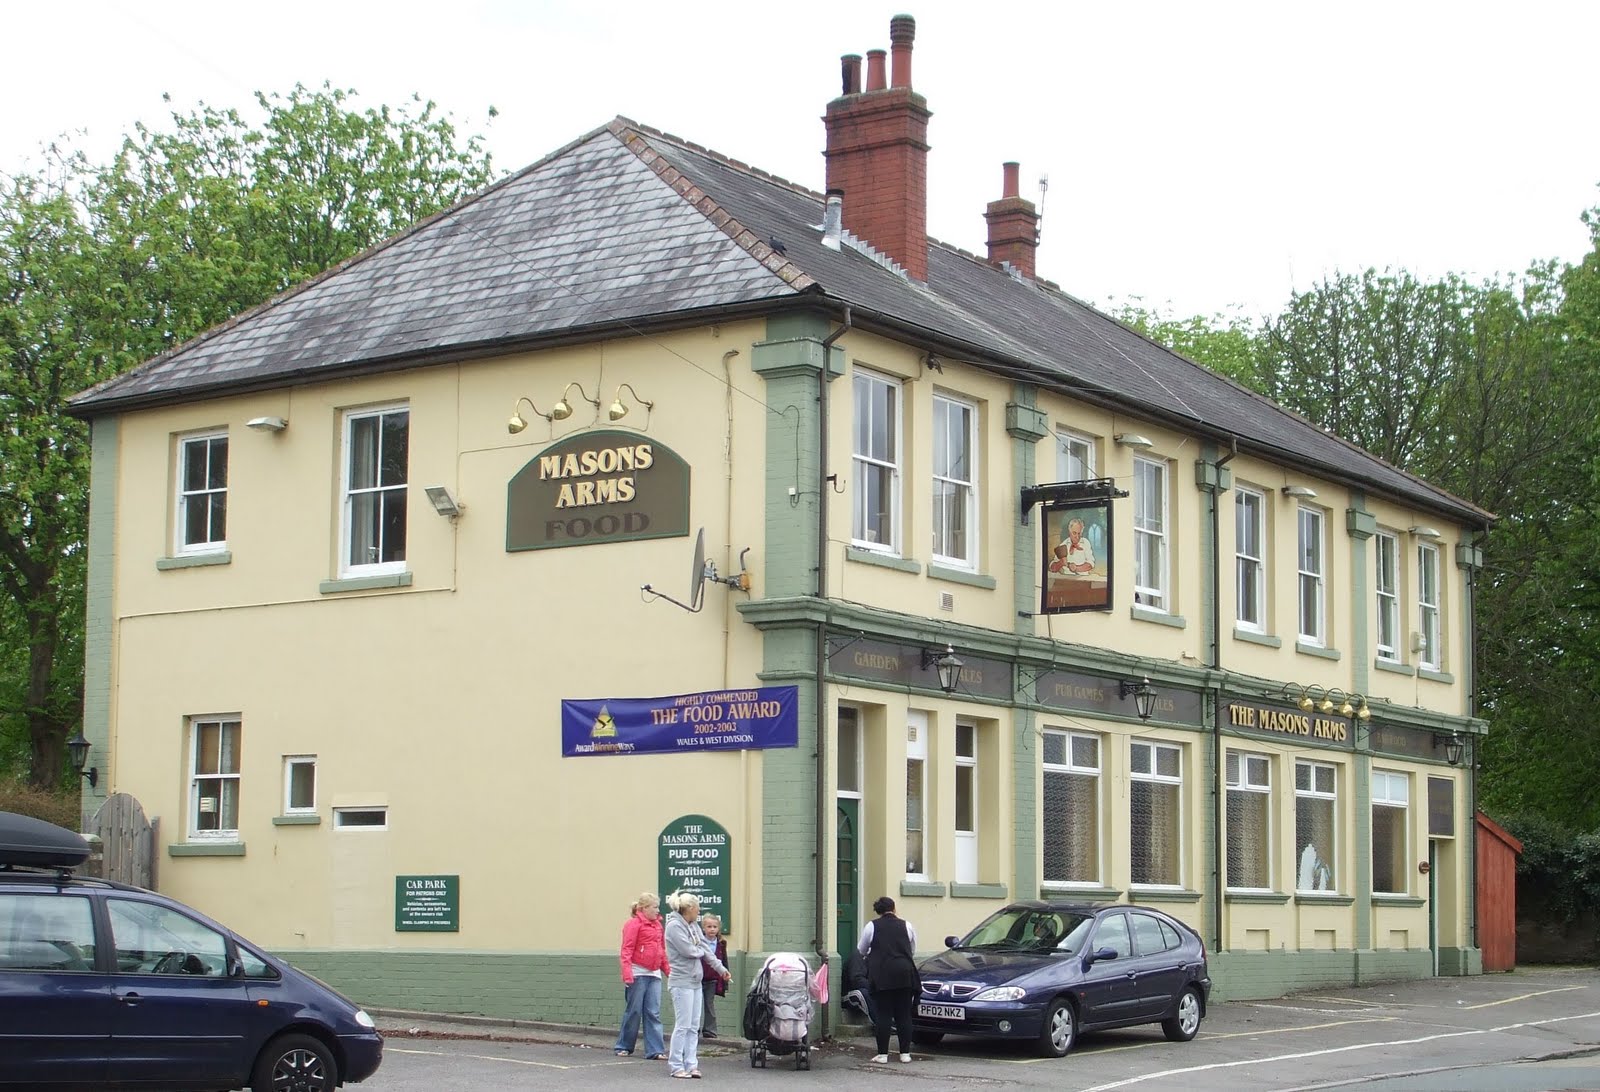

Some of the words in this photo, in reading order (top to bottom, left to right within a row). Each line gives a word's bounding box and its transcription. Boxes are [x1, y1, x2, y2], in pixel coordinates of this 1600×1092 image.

[540, 444, 653, 481] MASONS
[555, 477, 636, 509] ARMS
[545, 512, 650, 541] FOOD
[854, 651, 899, 671] GARDEN
[675, 696, 704, 706] HIGHLY
[706, 691, 759, 704] COMMENDED
[1055, 683, 1073, 697] PUB
[1074, 686, 1104, 702] GAMES
[651, 708, 678, 725] THE
[683, 704, 723, 723] FOOD
[727, 701, 781, 720] AWARD
[694, 722, 737, 734] 2002-2003
[1229, 704, 1255, 727] THE
[1259, 709, 1310, 736] MASONS
[1313, 718, 1347, 741] ARMS
[677, 738, 699, 746] WALES
[705, 736, 722, 744] WEST
[723, 734, 754, 743] DIVISION
[684, 825, 703, 833] THE
[662, 835, 698, 843] MASONS
[699, 834, 726, 843] ARMS
[669, 849, 689, 859] PUB
[691, 848, 719, 859] FOOD
[668, 866, 720, 876] Traditional
[406, 880, 423, 889] CAR
[424, 880, 447, 889] PARK
[683, 877, 705, 887] Ales
[697, 895, 722, 904] Darts
[921, 1005, 942, 1016] PF02
[944, 1008, 961, 1017] NKZ
